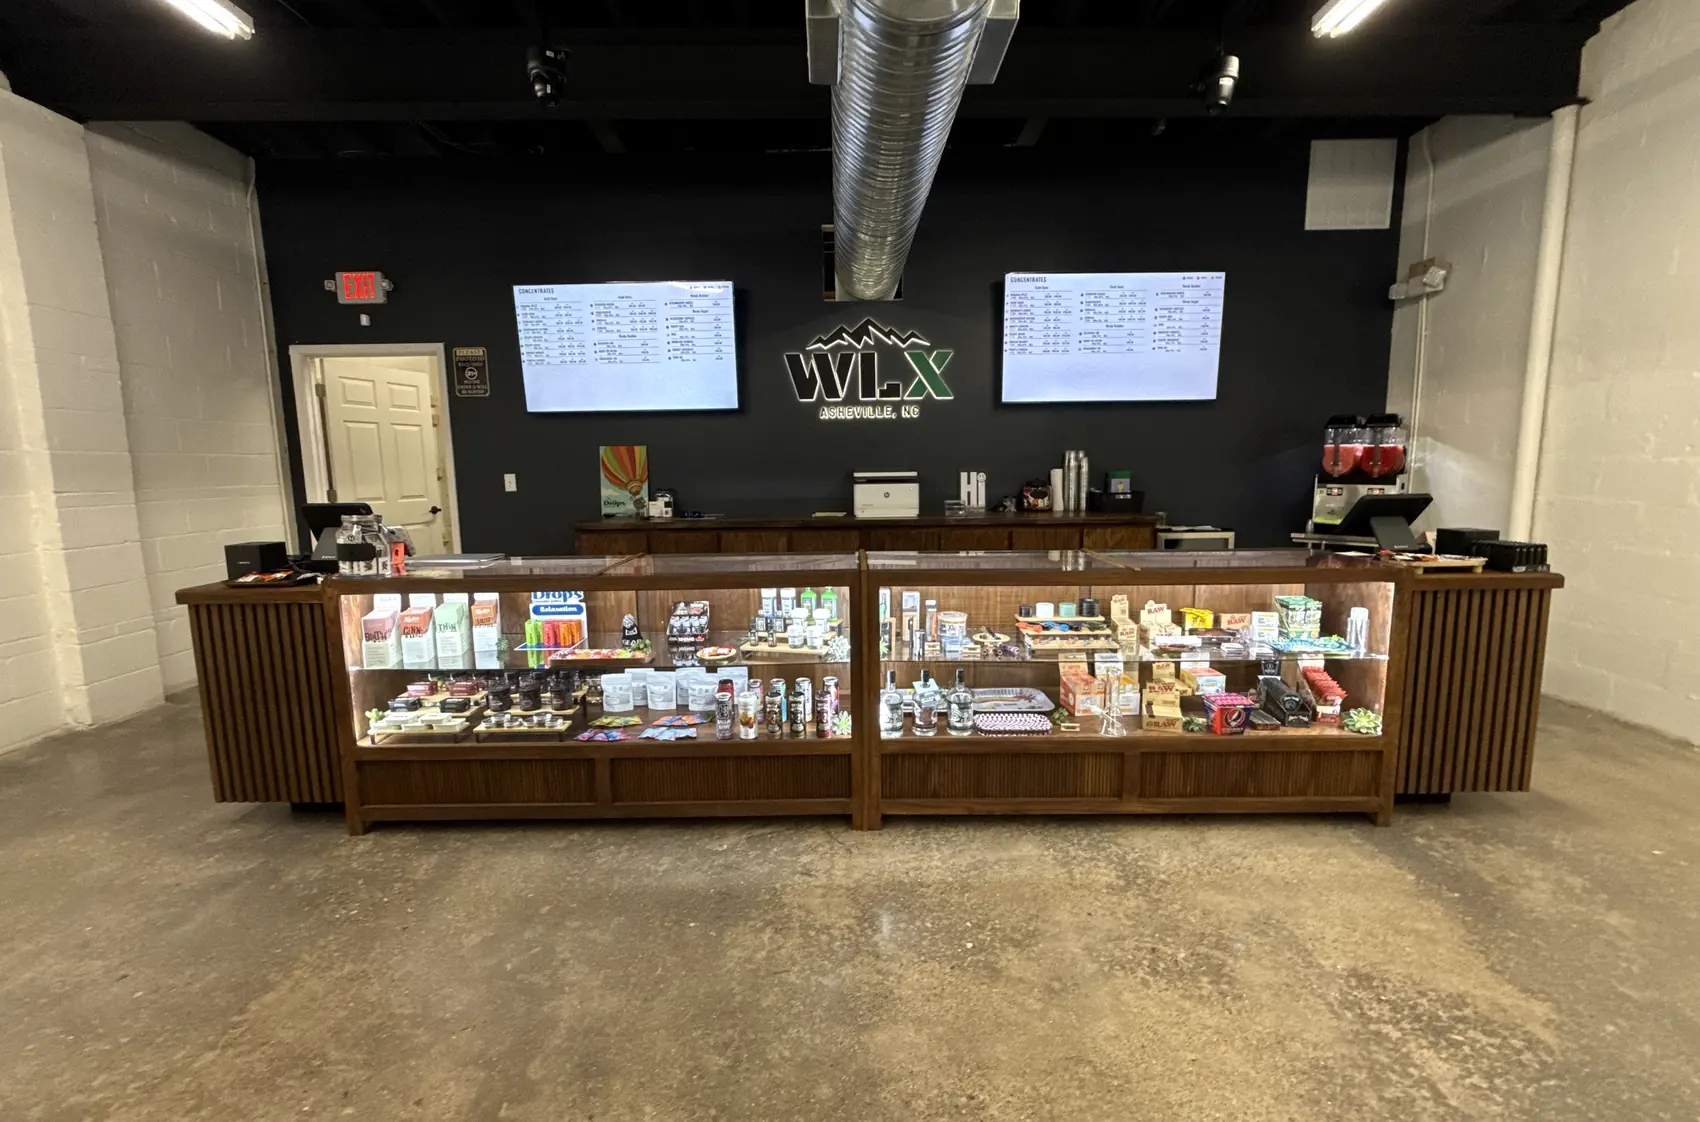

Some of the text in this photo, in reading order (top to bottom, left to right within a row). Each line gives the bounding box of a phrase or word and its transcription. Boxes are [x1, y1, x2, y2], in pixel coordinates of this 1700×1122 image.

[343, 272, 375, 299] EXIT
[518, 287, 555, 295] CONCENTRATES
[784, 350, 954, 402] WLX
[819, 405, 920, 420] ASHEVILLE, NC
[960, 471, 986, 506] Hi
[1147, 606, 1165, 614] RAW
[1227, 617, 1246, 625] RAW
